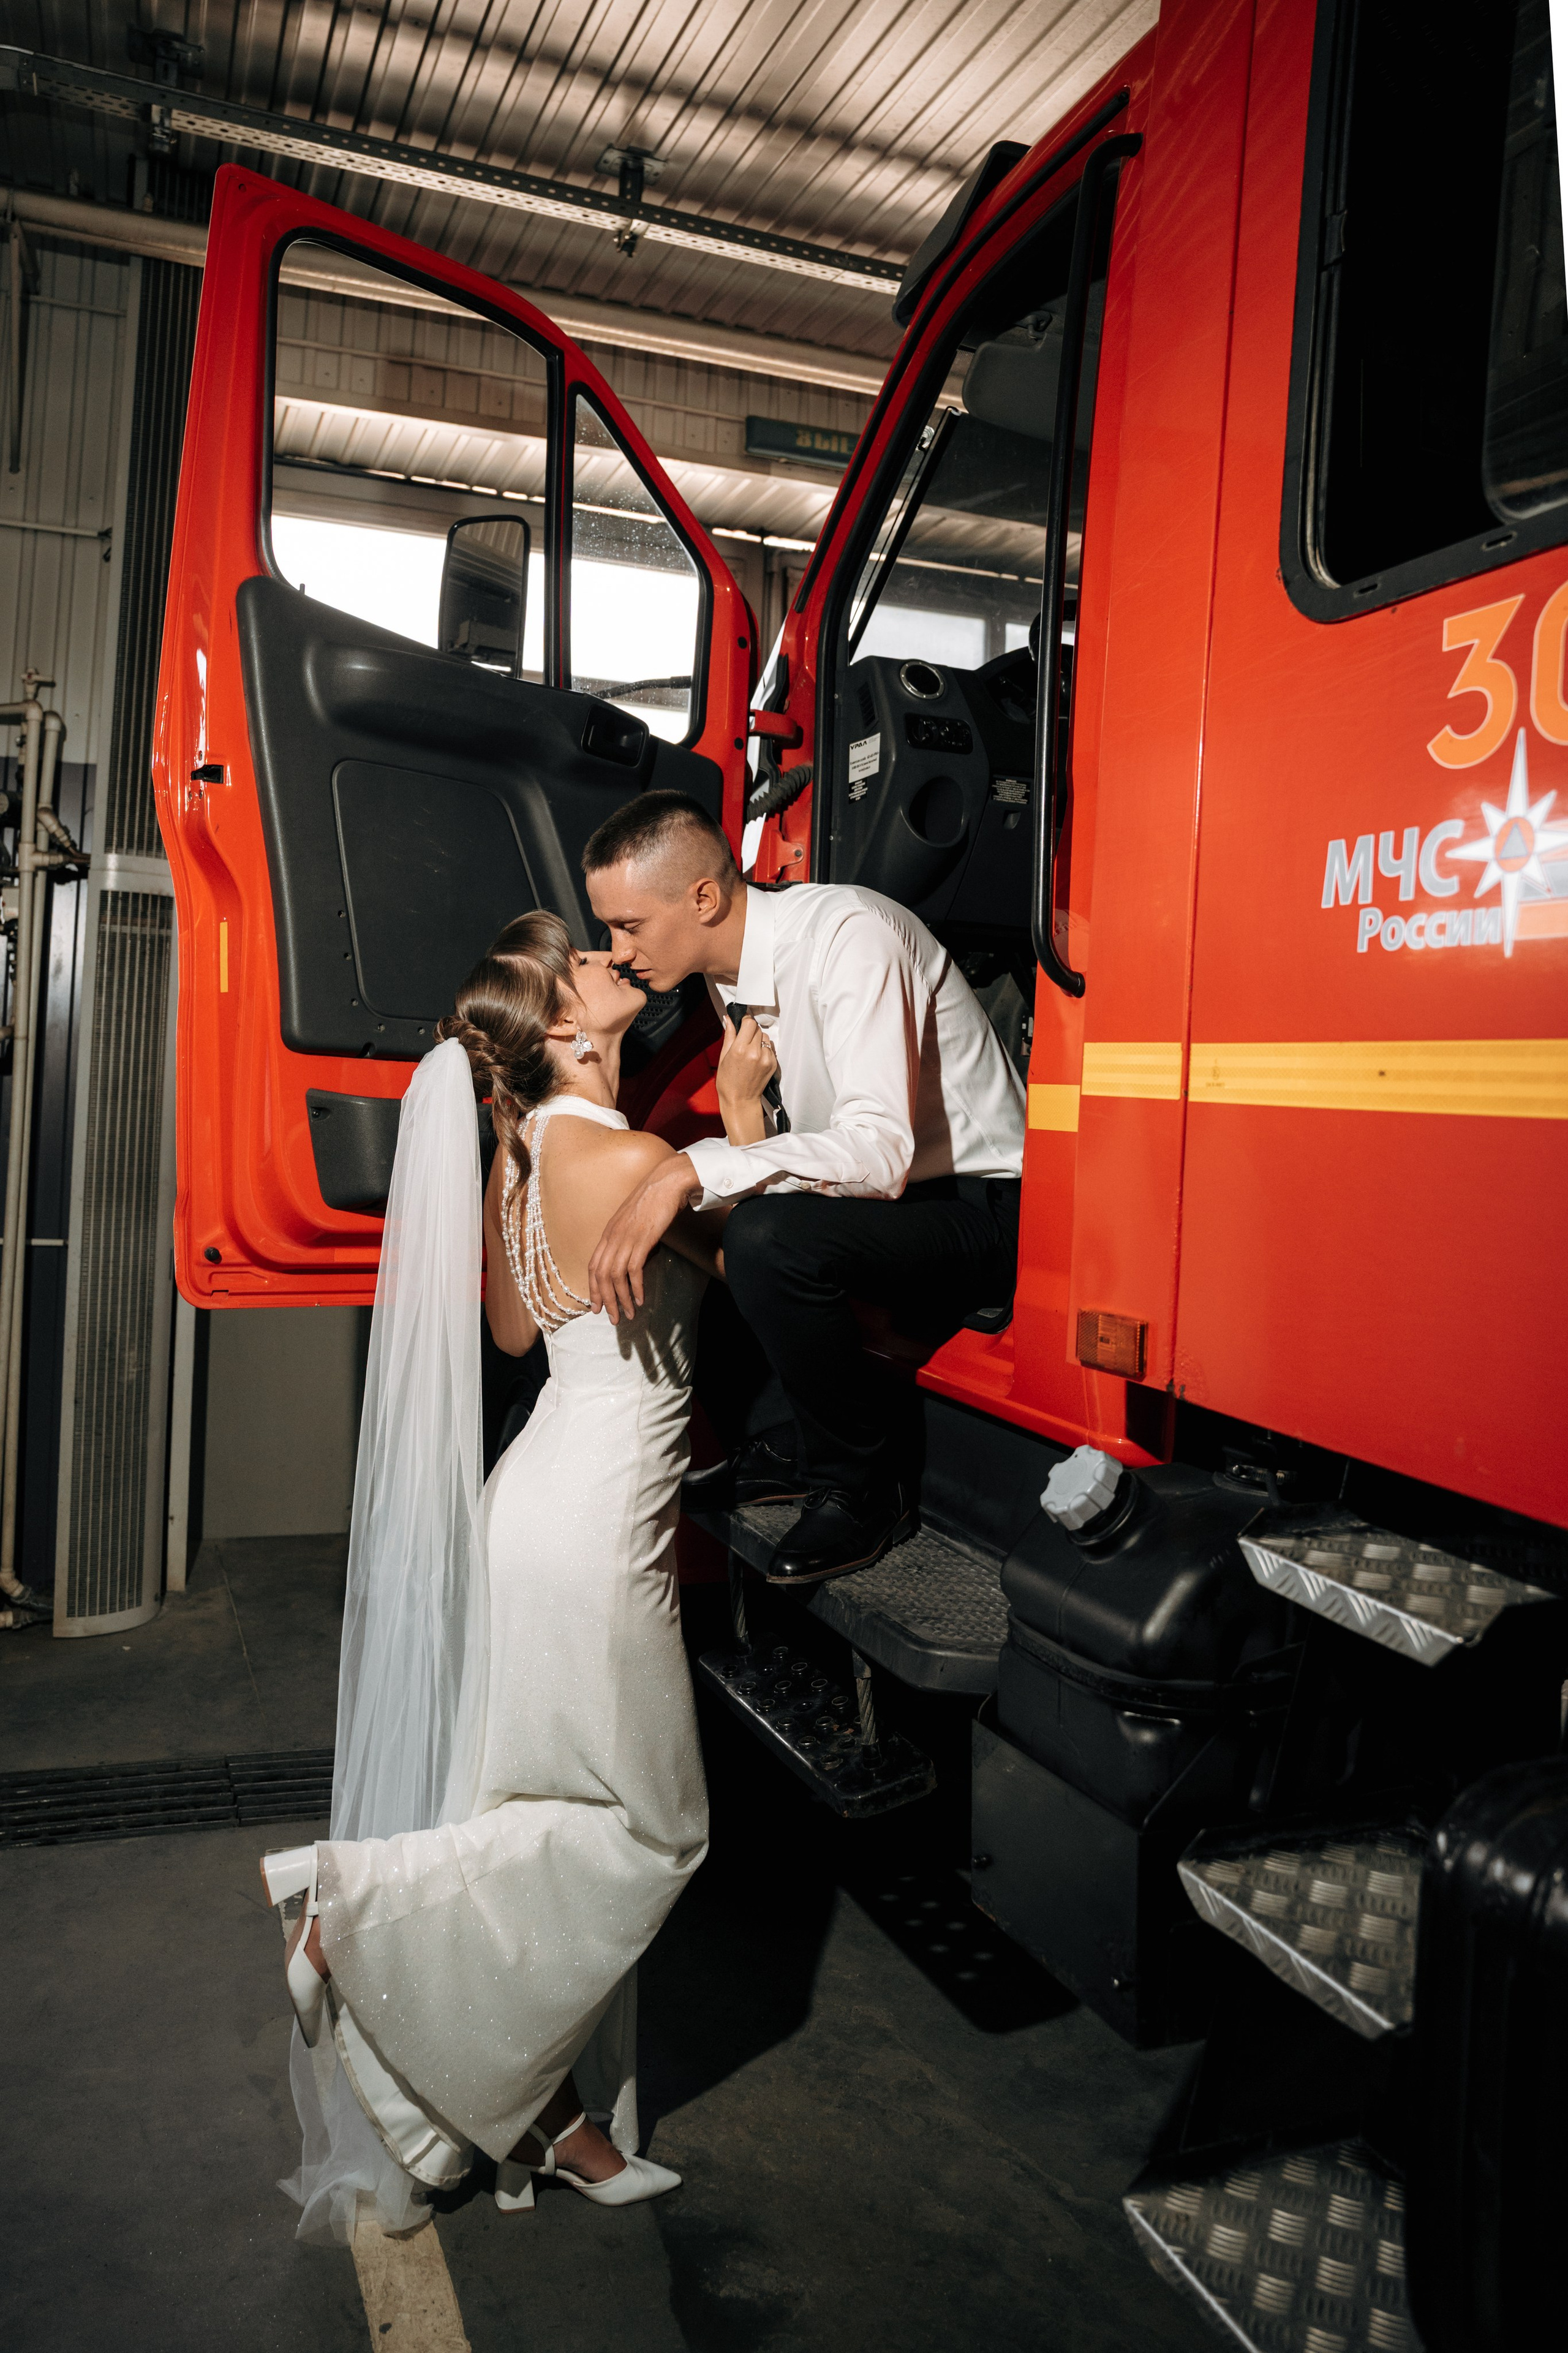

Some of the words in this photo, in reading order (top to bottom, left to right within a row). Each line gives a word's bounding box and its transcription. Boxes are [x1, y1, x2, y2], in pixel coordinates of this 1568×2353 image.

[850, 740, 867, 750] УРАЛ
[1321, 818, 1466, 908] МЧС
[1357, 906, 1502, 953] России
